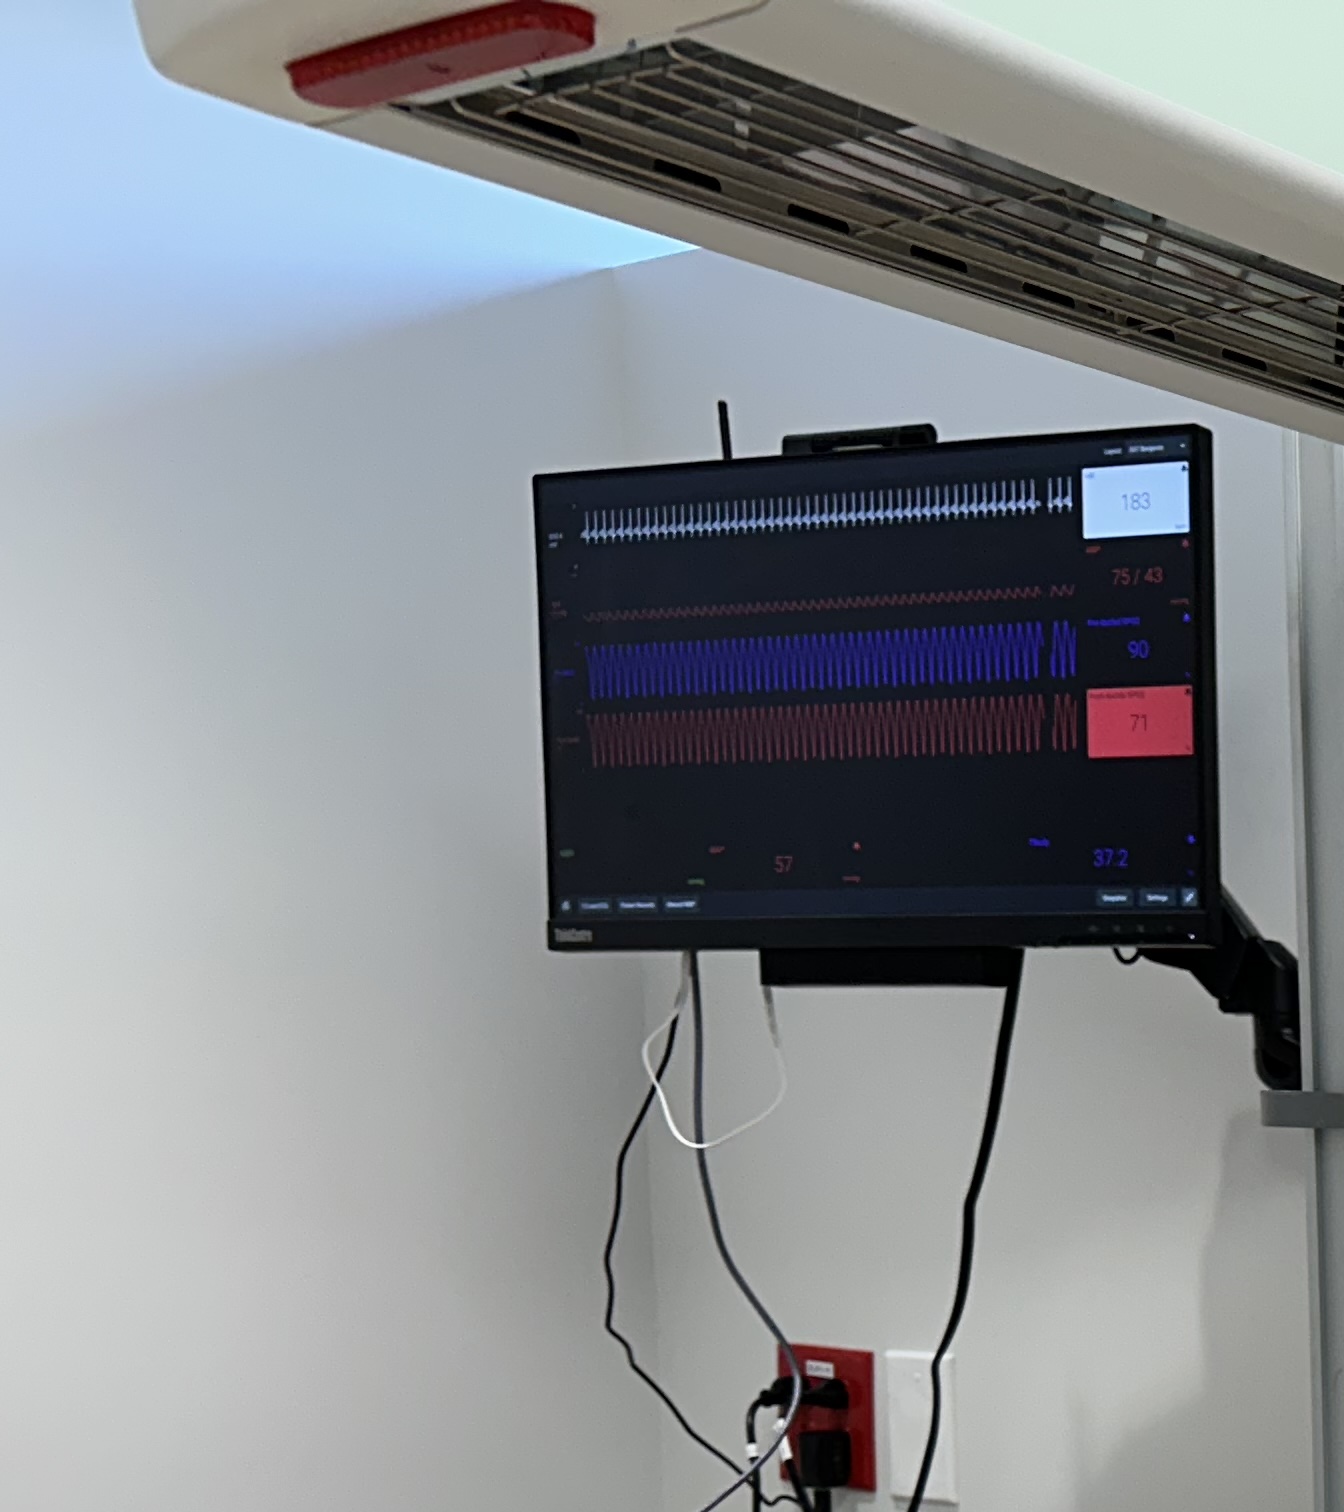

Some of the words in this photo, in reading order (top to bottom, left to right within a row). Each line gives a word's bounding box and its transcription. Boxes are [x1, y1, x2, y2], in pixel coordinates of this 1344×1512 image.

[1121, 491, 1152, 511] 183
[1111, 568, 1131, 585] 75
[1143, 566, 1164, 584] 43
[1127, 639, 1150, 659] 90
[1129, 713, 1148, 732] 71
[774, 855, 793, 873] 57
[1093, 848, 1129, 868] 37.2
